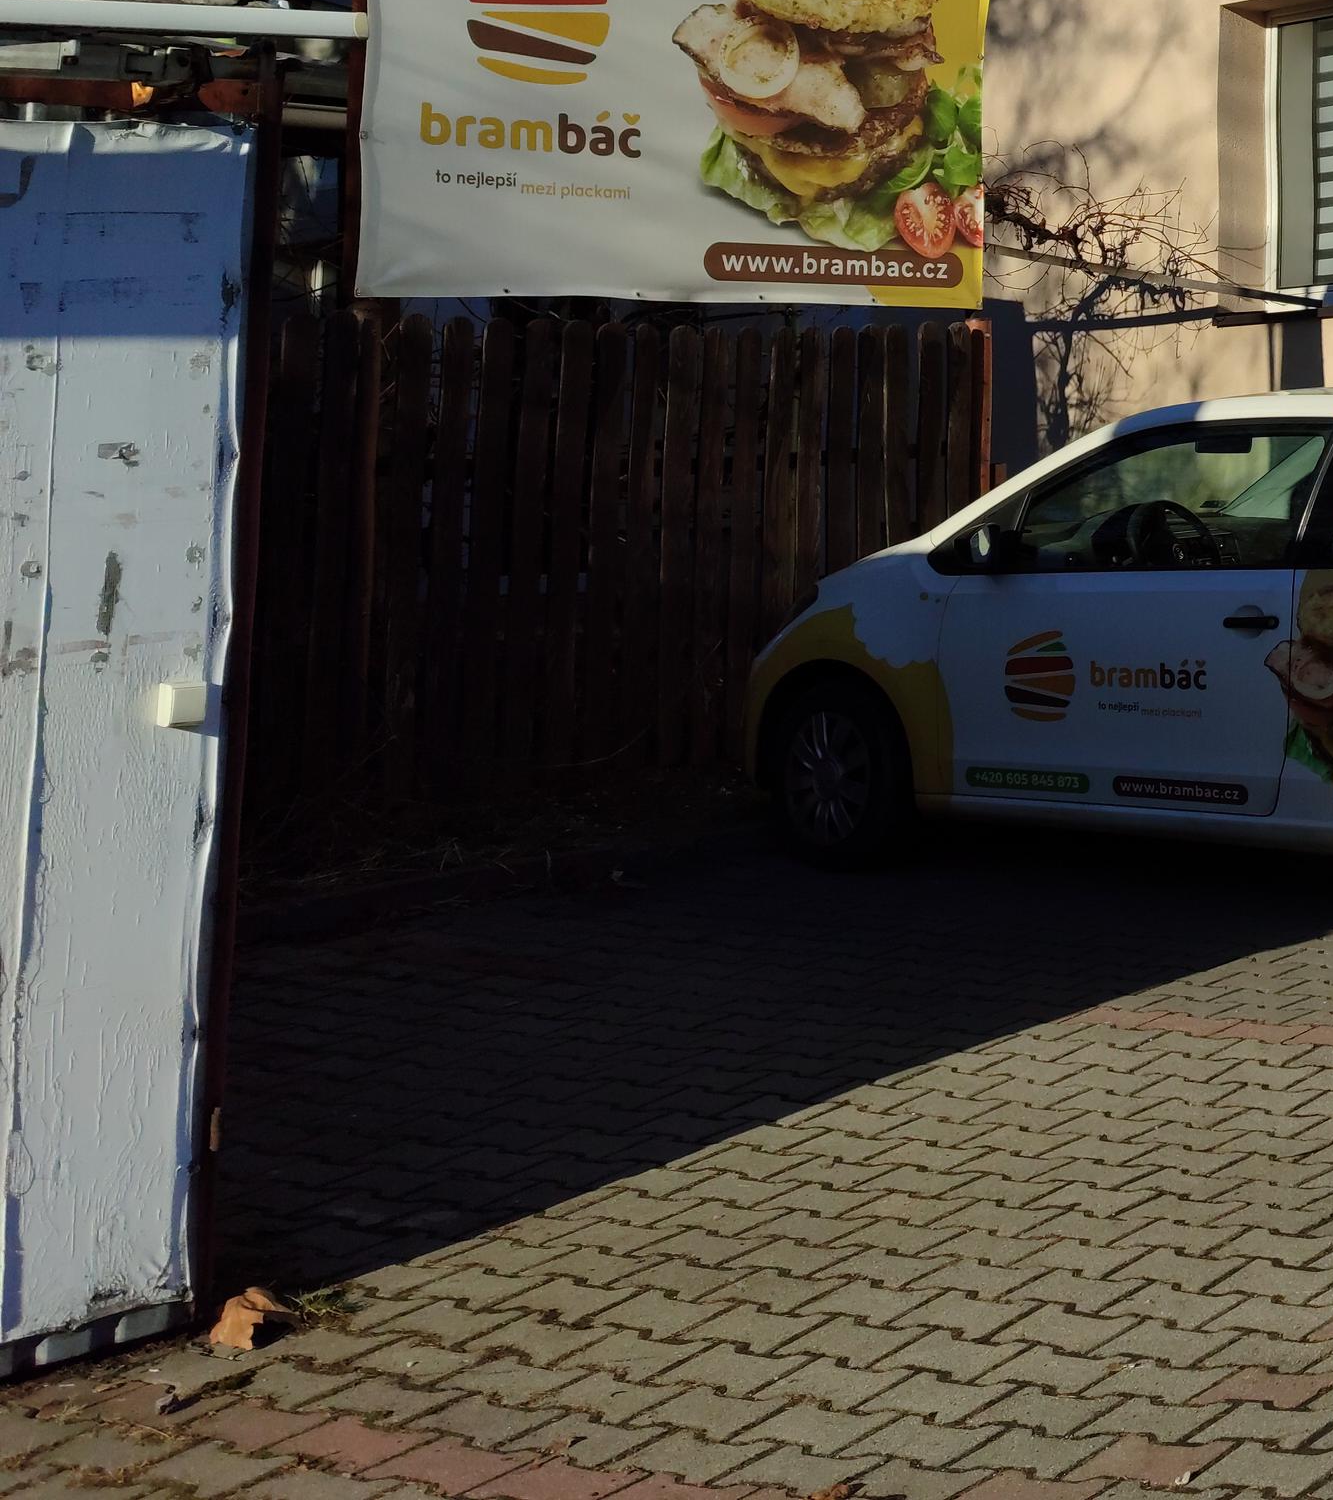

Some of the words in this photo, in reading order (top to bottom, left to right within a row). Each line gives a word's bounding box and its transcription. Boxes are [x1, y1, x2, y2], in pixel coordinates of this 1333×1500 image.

[420, 101, 642, 159] brambáč
[436, 169, 451, 184] to
[456, 171, 517, 188] nejlepší
[521, 182, 556, 197] mezi
[560, 184, 631, 200] plackami
[721, 252, 948, 279] www.brambac.cz
[1090, 659, 1207, 690] brambáč
[975, 771, 1003, 784] +420
[1006, 772, 1029, 786] 605
[1032, 773, 1055, 788] 845
[1057, 774, 1081, 789] 873
[1119, 780, 1240, 801] www.brambac.cz
